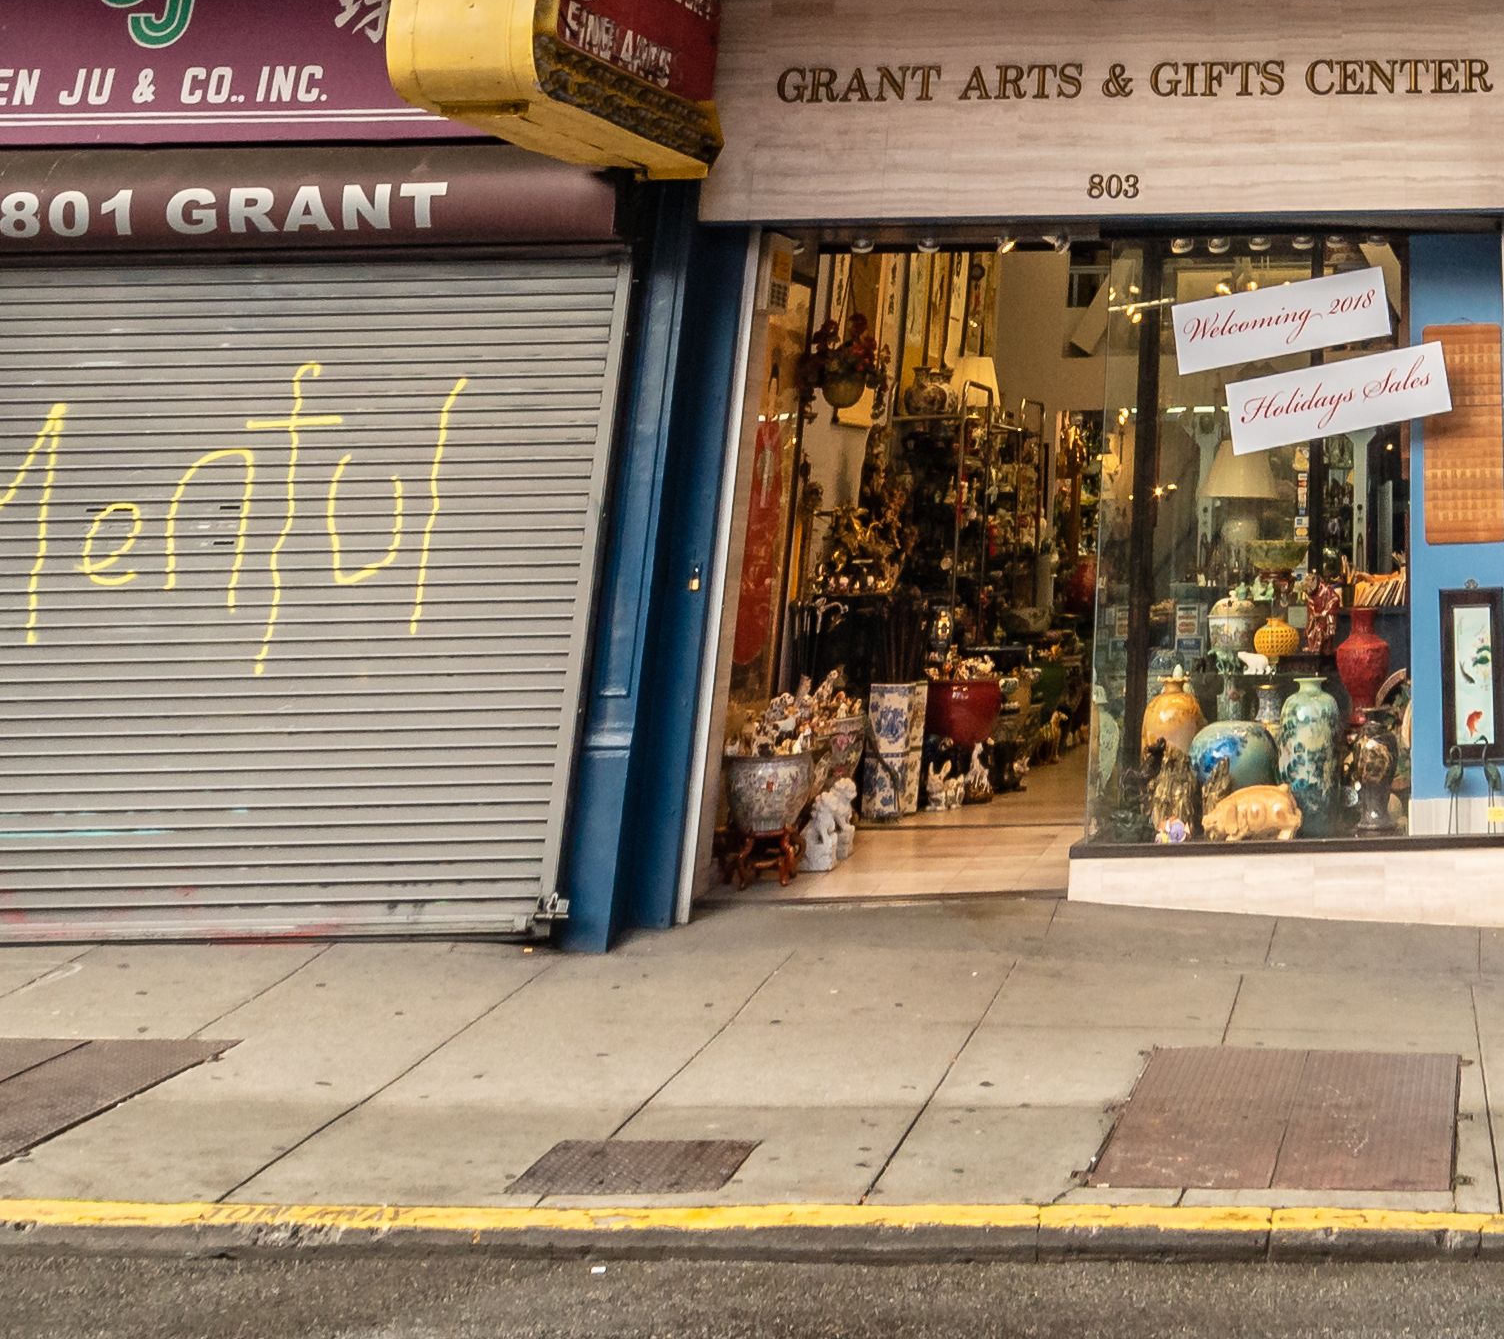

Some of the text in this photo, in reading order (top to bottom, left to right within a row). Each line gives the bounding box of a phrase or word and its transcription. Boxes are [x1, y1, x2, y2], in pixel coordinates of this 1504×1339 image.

[58, 67, 117, 106] JU
[132, 67, 156, 104] &
[255, 65, 329, 103] INC.
[776, 58, 1494, 104] GRANT ARTS & GIFTS CENTER
[165, 180, 449, 236] GRANT
[1086, 173, 1140, 200] 803
[1182, 289, 1376, 345] Welcoming 2018
[1240, 355, 1433, 429] Holidays Sales
